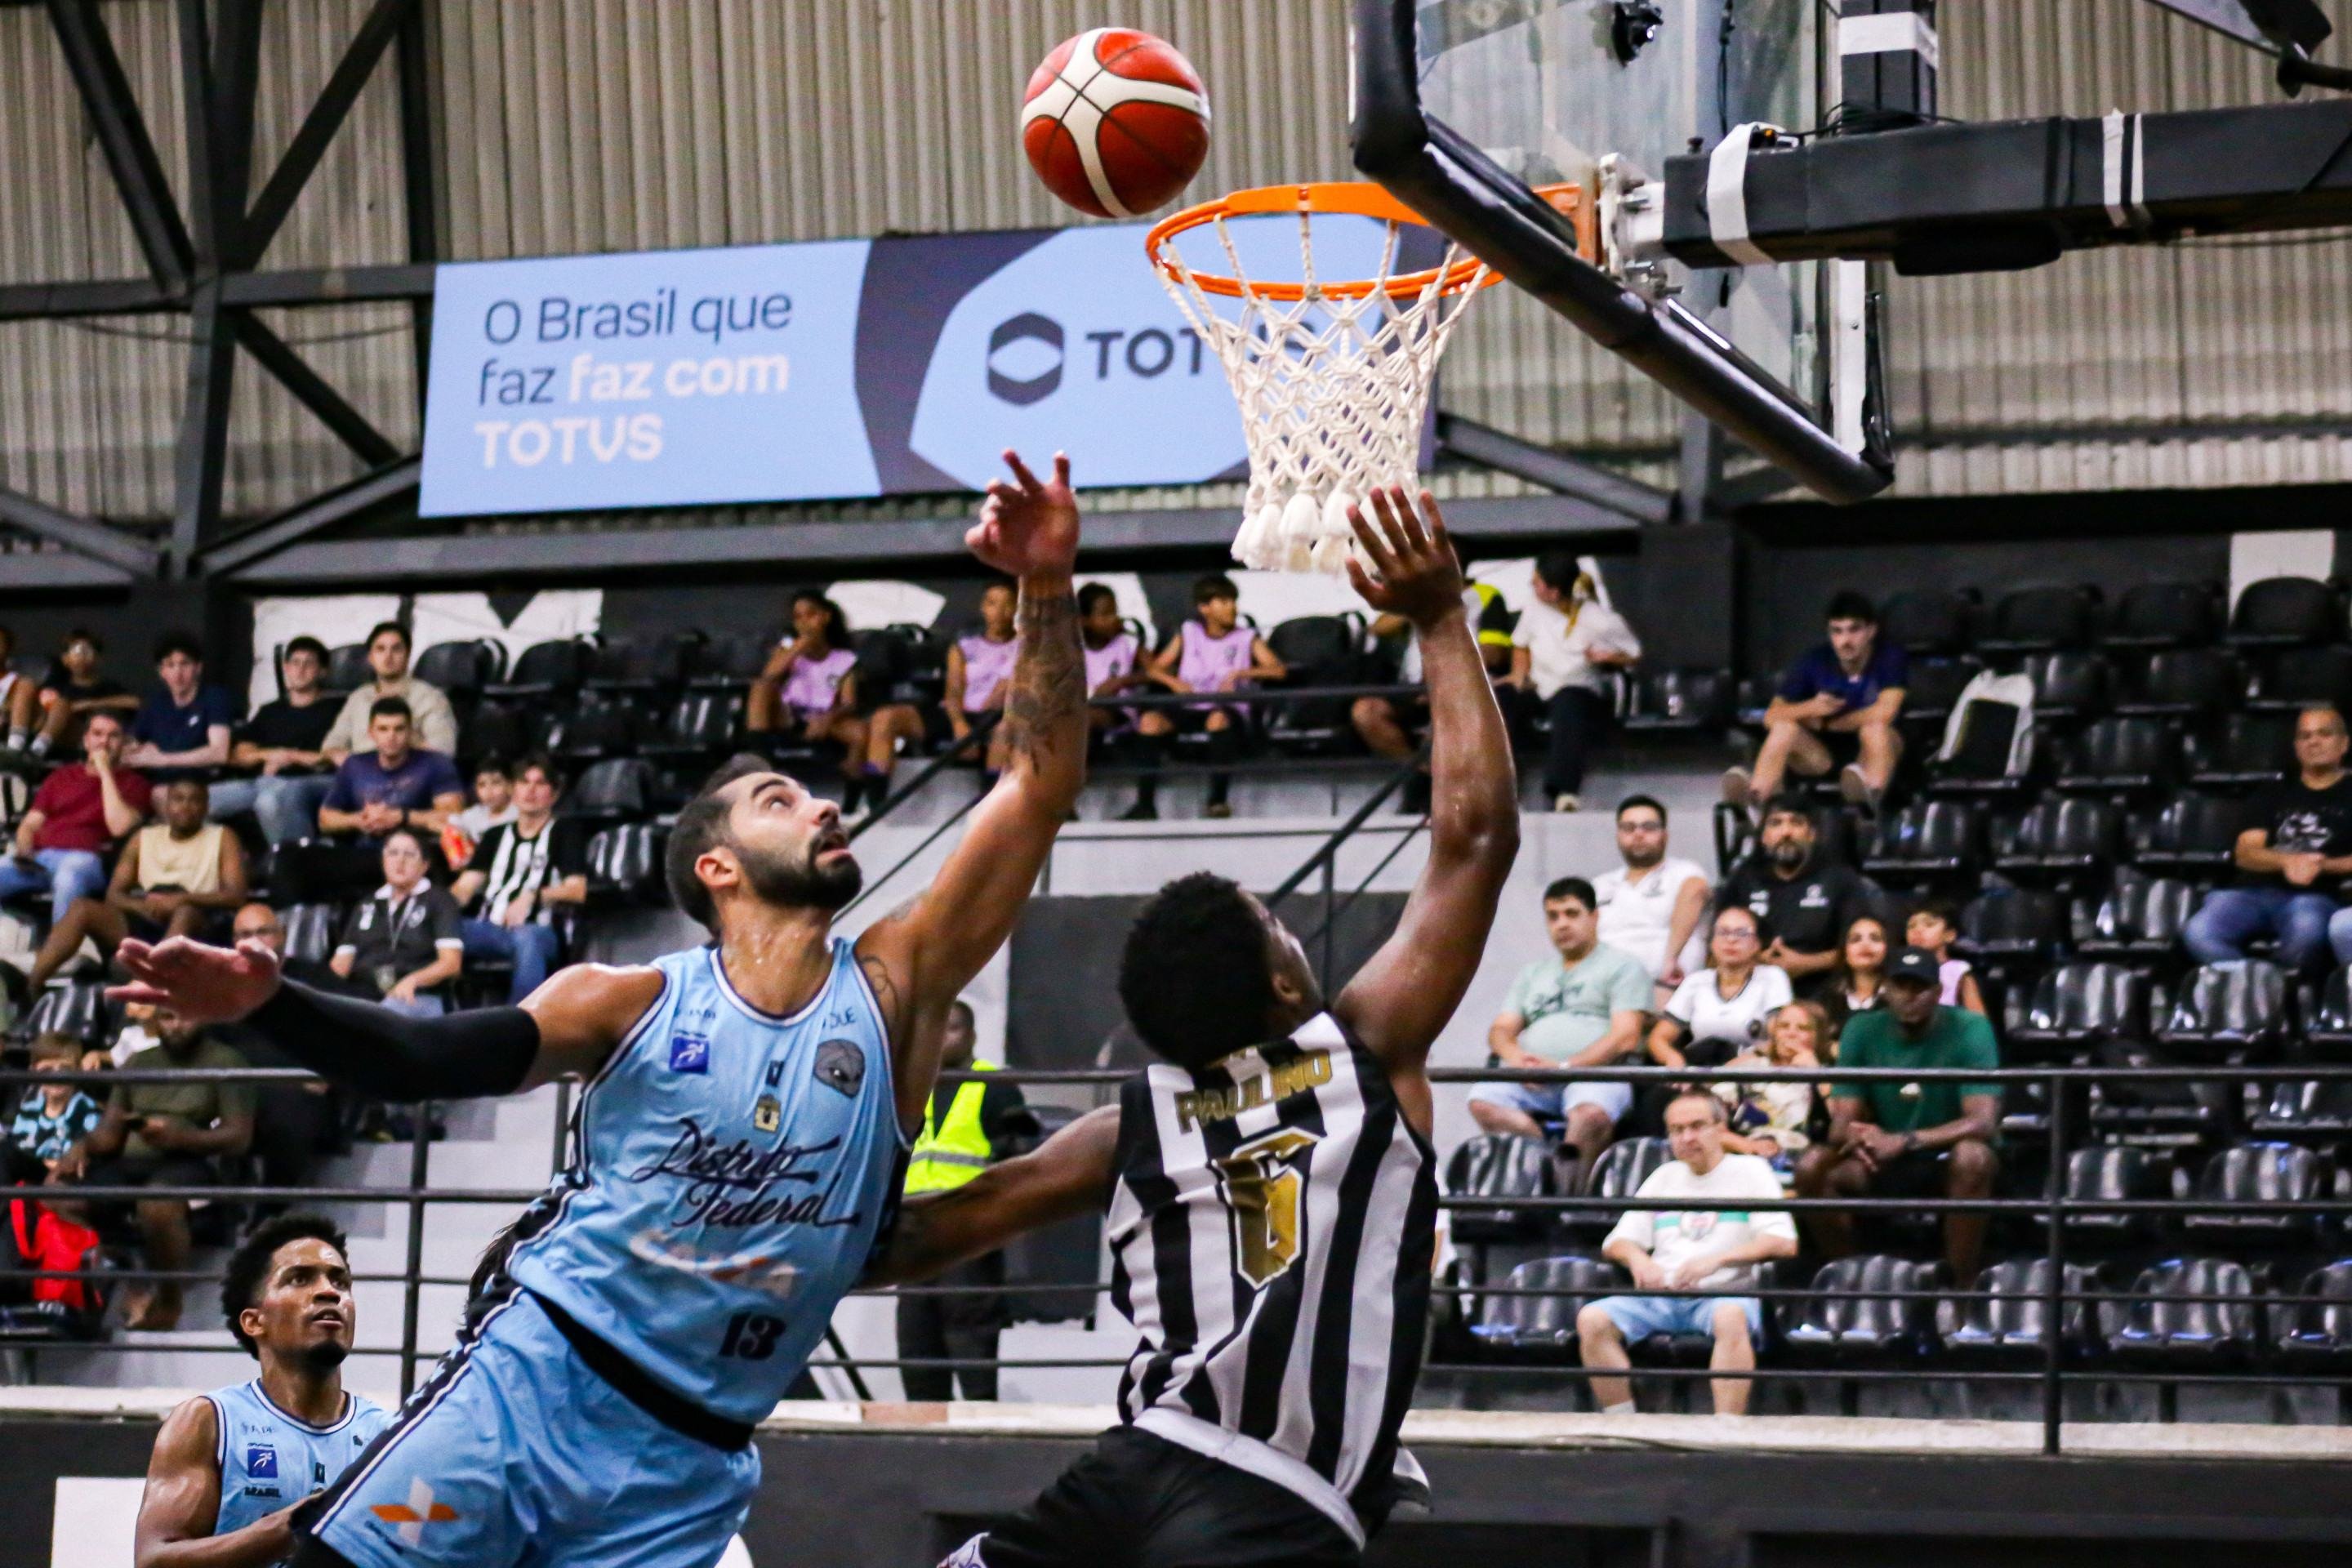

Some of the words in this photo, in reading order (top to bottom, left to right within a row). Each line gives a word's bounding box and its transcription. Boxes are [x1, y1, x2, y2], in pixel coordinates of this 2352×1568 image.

[484, 299, 521, 345] O
[537, 288, 676, 342] Brasil
[691, 293, 792, 345] que
[479, 358, 556, 406] faz
[567, 353, 653, 403] faz
[664, 353, 790, 398] com
[474, 413, 663, 470] TOTVS
[671, 1173, 861, 1227] Federal
[1211, 1126, 1326, 1290] 6
[718, 1312, 787, 1361] 13
